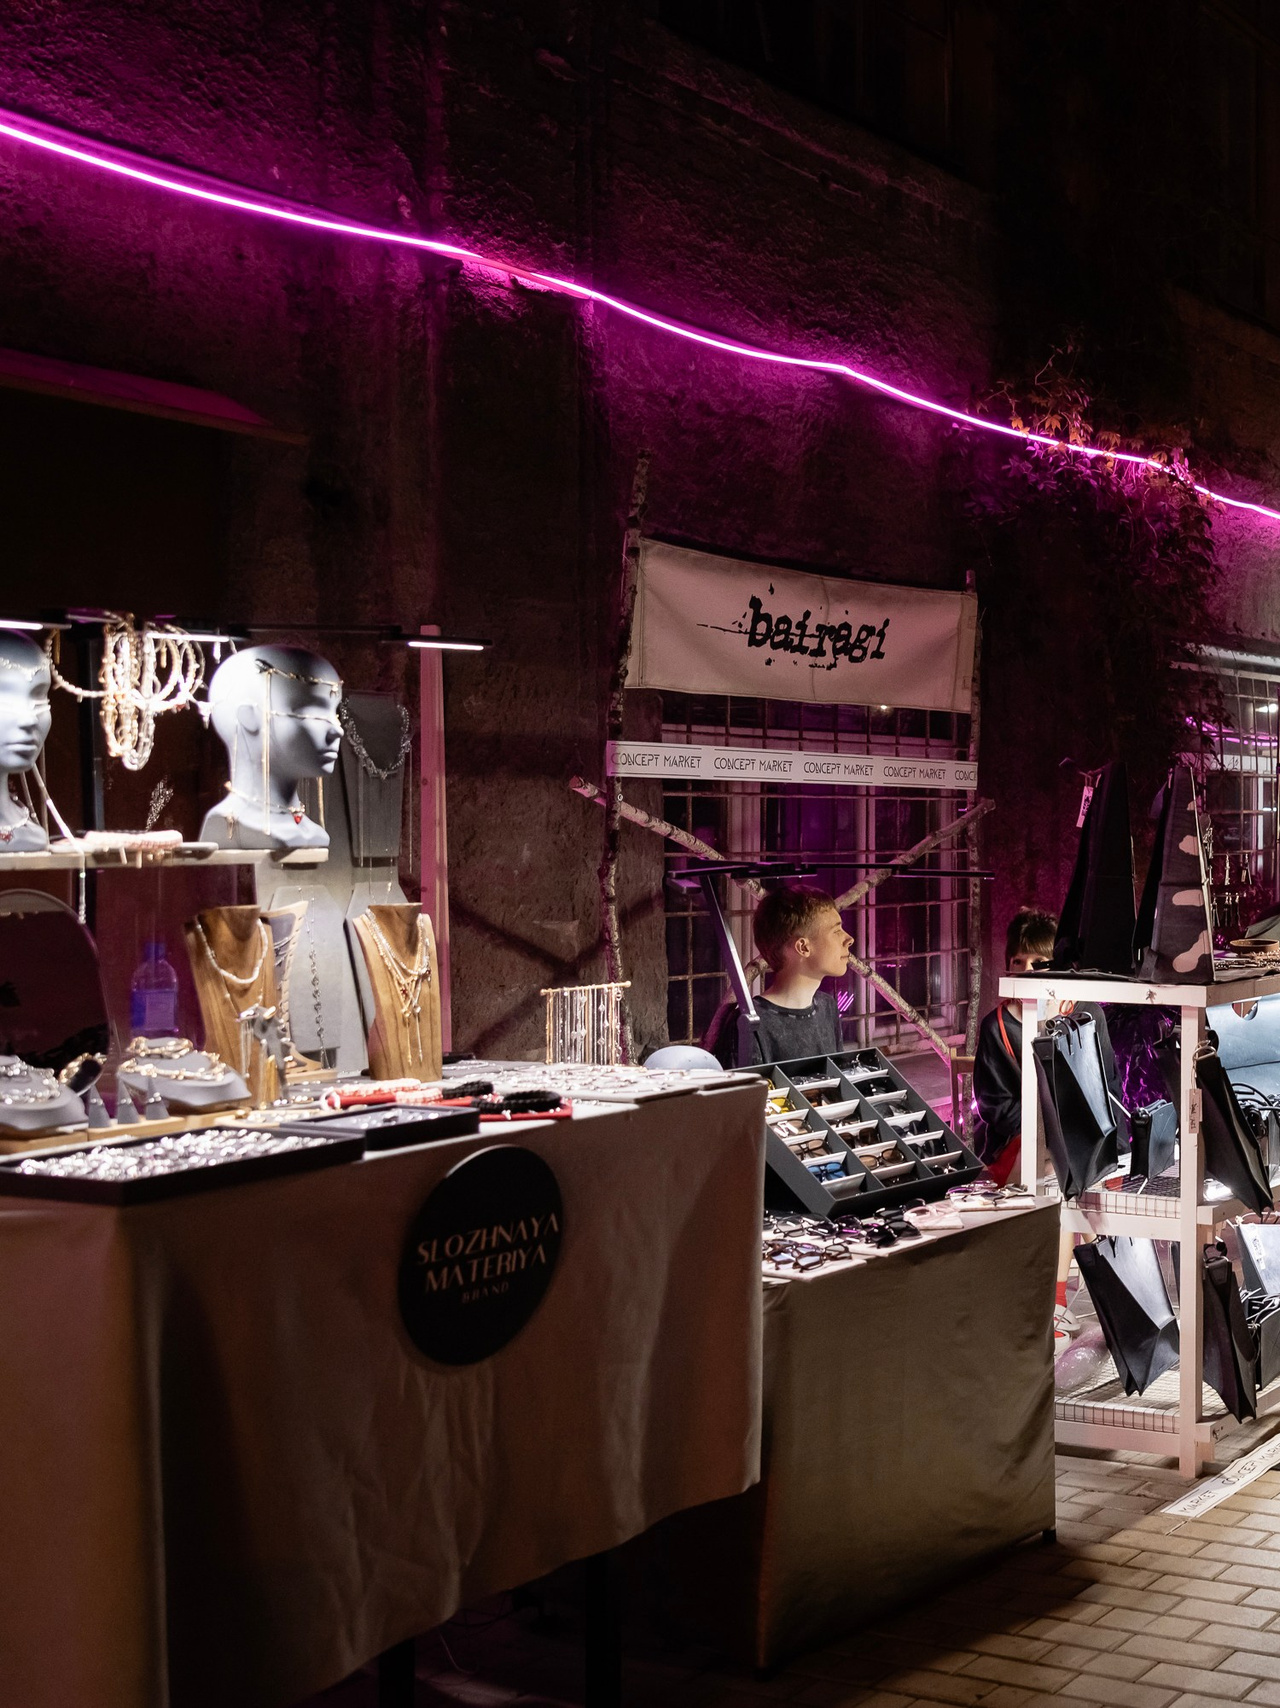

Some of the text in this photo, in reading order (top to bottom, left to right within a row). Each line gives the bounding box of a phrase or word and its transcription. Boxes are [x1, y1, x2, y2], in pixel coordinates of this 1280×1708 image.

[611, 752, 702, 769] CONCEPT MARKET
[713, 757, 793, 773] CONCEPT MARKET
[803, 761, 875, 777] CONCEPT MARKET
[883, 765, 947, 780] CONCEPT MARKET
[417, 1212, 559, 1265] SLOZHNAYA
[425, 1244, 547, 1294] MATERIYA
